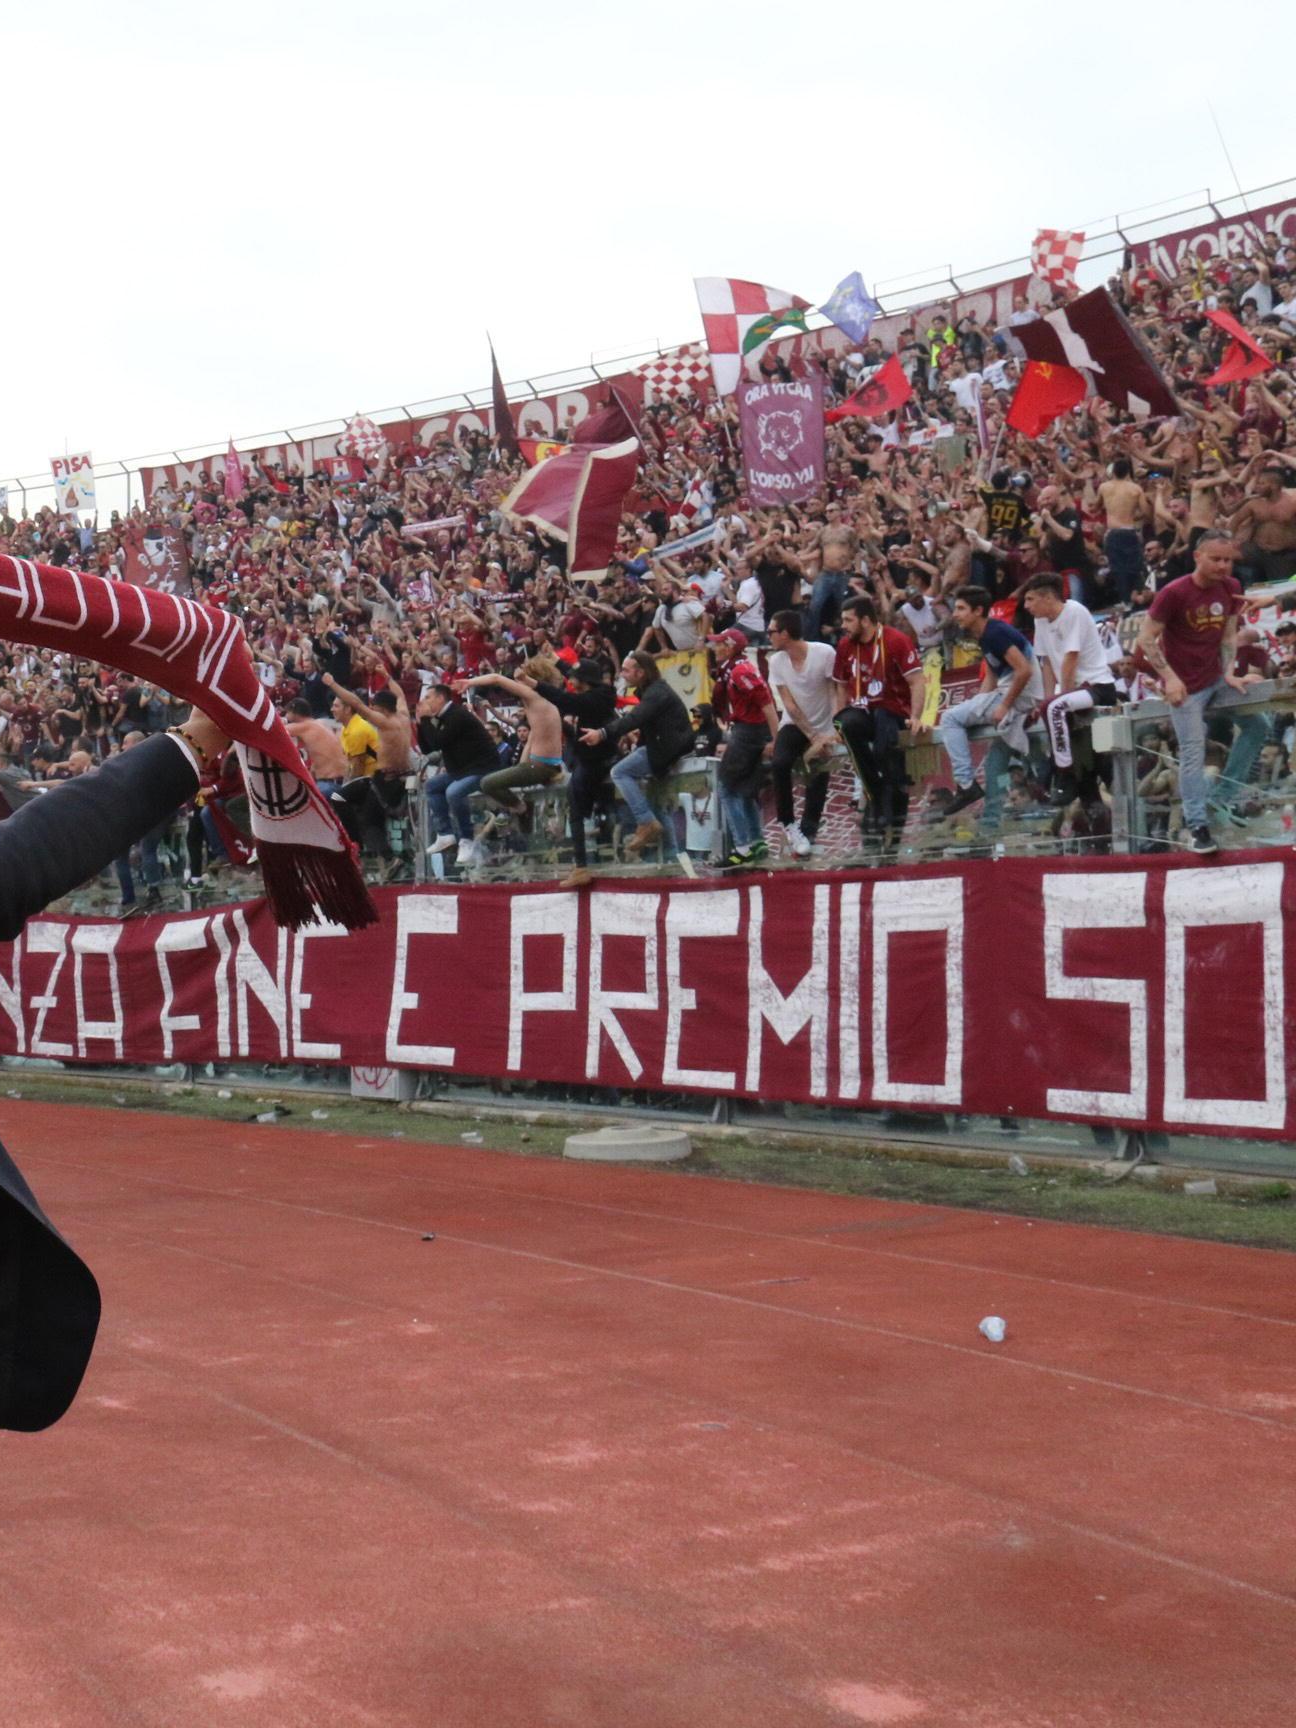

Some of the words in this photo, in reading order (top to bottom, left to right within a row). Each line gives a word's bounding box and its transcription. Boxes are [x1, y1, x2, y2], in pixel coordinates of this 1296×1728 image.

[51, 455, 93, 478] PISA
[155, 906, 349, 1060] FINE
[385, 894, 458, 1067] E
[507, 877, 965, 1106] PREMIO
